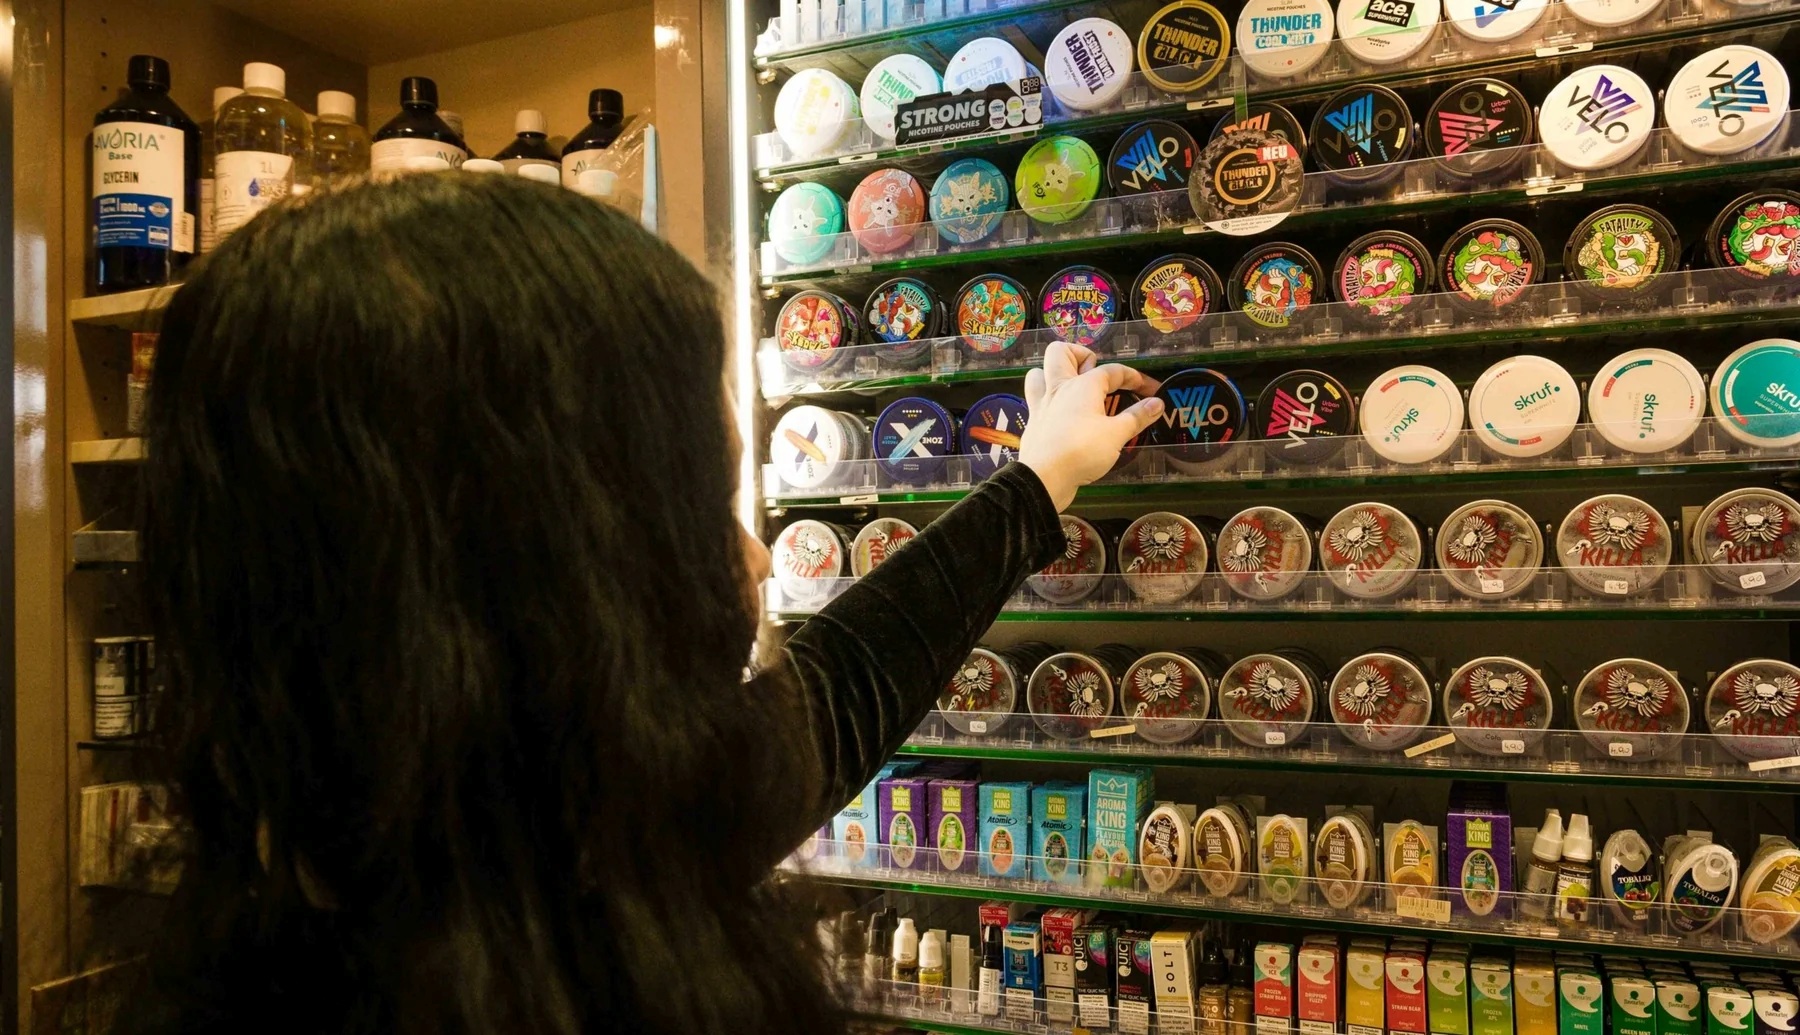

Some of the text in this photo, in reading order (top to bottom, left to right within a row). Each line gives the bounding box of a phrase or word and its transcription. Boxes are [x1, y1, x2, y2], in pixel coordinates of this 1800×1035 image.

[1251, 13, 1322, 34] THUNDER
[1367, 11, 1401, 24] SUPERWHITE
[1154, 23, 1219, 57] THUNDER
[1257, 33, 1313, 48] COOL MINT
[1065, 33, 1104, 95] THUNDER
[878, 69, 918, 99] THUND
[1491, 98, 1512, 109] Urban
[1706, 59, 1745, 136] VELO
[901, 99, 985, 129] STRONG
[1567, 85, 1629, 144] VELO
[908, 127, 944, 138] NICOTINE
[945, 120, 980, 133] POUCHES
[1323, 109, 1397, 154] VELO
[1460, 91, 1490, 166] VELO
[108, 151, 133, 160] Base
[1262, 146, 1288, 161] NEU
[1121, 137, 1180, 190] VELO
[103, 171, 139, 185] GLYCERIN
[1222, 165, 1269, 181] THUNDER
[1599, 218, 1648, 232] FATALITY!
[1146, 267, 1181, 291] FATALITY!
[1345, 259, 1359, 302] FATALITY!
[900, 286, 928, 310] FATALITY!
[1766, 382, 1800, 408] skru
[1322, 400, 1340, 408] Urban
[1163, 404, 1229, 429] VELO
[1285, 382, 1319, 449] VELO
[922, 436, 944, 445] ZONE
[1263, 530, 1283, 582] KILLA
[1354, 536, 1400, 584] KILLA
[1483, 529, 1515, 578] KILLA
[1580, 546, 1644, 567] KILLA
[1726, 540, 1787, 565] KILLA
[784, 560, 821, 578] KILLA
[1138, 559, 1189, 577] KILLA
[1144, 696, 1191, 724] KILLA
[1233, 696, 1285, 724] KILLA
[1467, 709, 1526, 728] KILLA
[1595, 711, 1660, 734] KILLA
[1731, 716, 1800, 736] KILLA
[892, 797, 909, 805] KING
[942, 797, 960, 805] KING
[993, 798, 1011, 809] KING
[1048, 803, 1065, 814] KING
[1096, 799, 1127, 811] AROMA
[840, 810, 864, 818] Atomic
[987, 815, 1013, 825] Atomic
[1096, 812, 1126, 828] KING
[1041, 822, 1067, 830] Atomic
[1468, 822, 1489, 830] AROMA
[1096, 831, 1126, 840] FLAVOUR
[1156, 831, 1170, 841] KING
[1206, 838, 1221, 847] KING
[1468, 831, 1490, 842] KING
[1273, 842, 1290, 851] KING
[1329, 846, 1345, 855] KING
[1403, 849, 1419, 858] KING
[1617, 874, 1653, 884] TOBALIQ
[1776, 876, 1797, 890] KING
[1780, 870, 1799, 882] AROMA
[1683, 880, 1721, 903] TOBALIQ
[1675, 919, 1694, 930] CHERRY
[1054, 961, 1068, 972] T3
[1164, 951, 1177, 993] SOLT
[1574, 1023, 1589, 1031] MNTL
